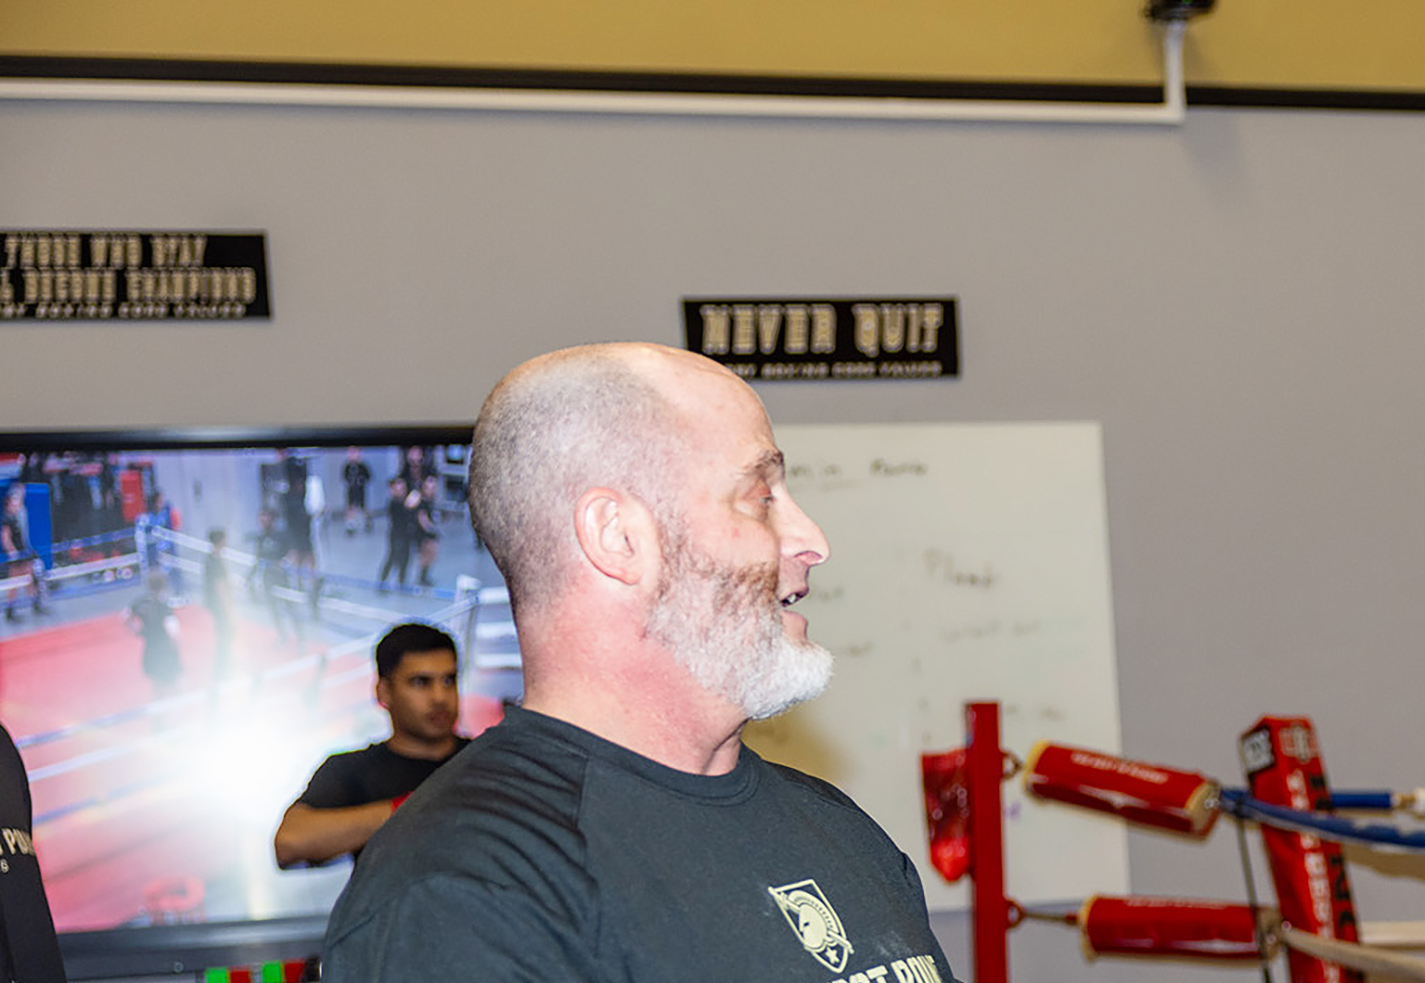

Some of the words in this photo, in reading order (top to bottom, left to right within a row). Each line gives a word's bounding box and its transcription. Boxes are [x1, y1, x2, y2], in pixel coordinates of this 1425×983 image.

[90, 235, 142, 269] WHO
[125, 267, 256, 303] CHAMPIONS
[700, 304, 836, 354] NEVER
[852, 303, 943, 357] QUIT
